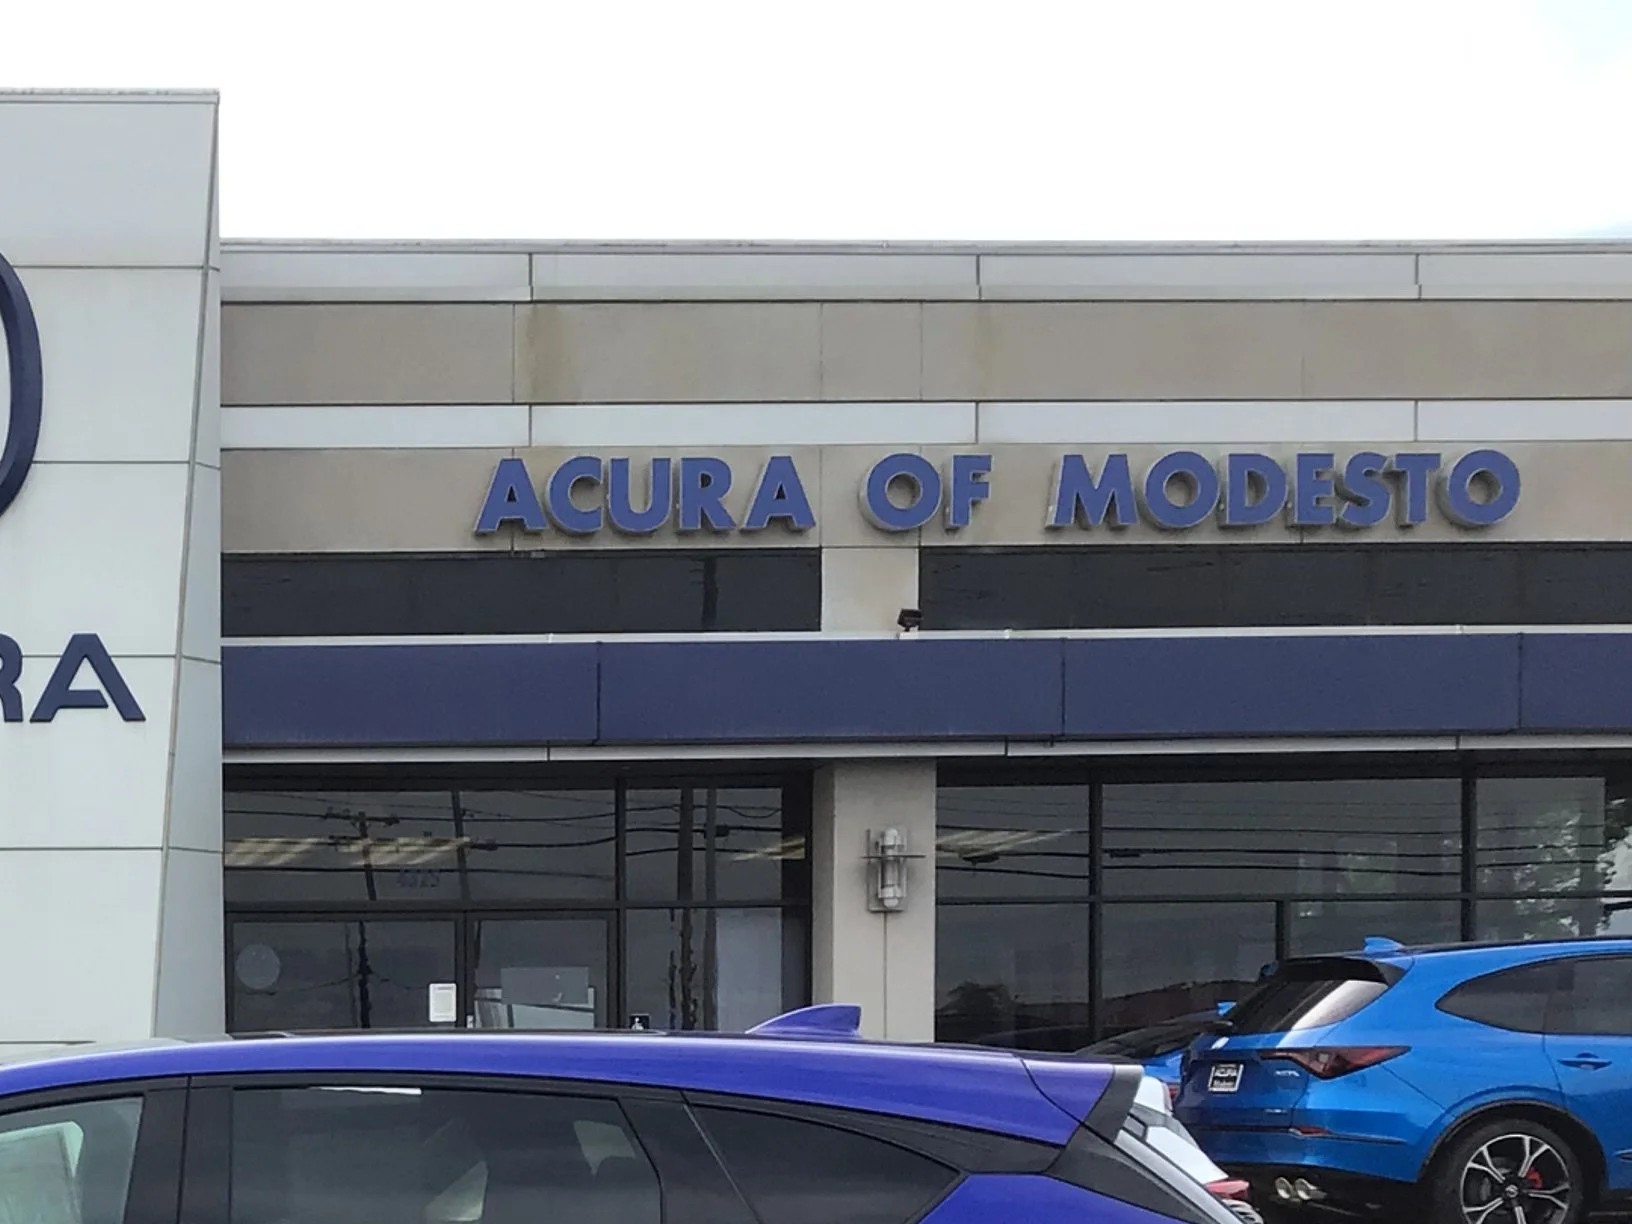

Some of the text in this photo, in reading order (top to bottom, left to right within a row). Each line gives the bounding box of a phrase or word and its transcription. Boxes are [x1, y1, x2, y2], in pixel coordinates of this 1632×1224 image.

[474, 449, 1521, 533] ACURA OF MODESTO
